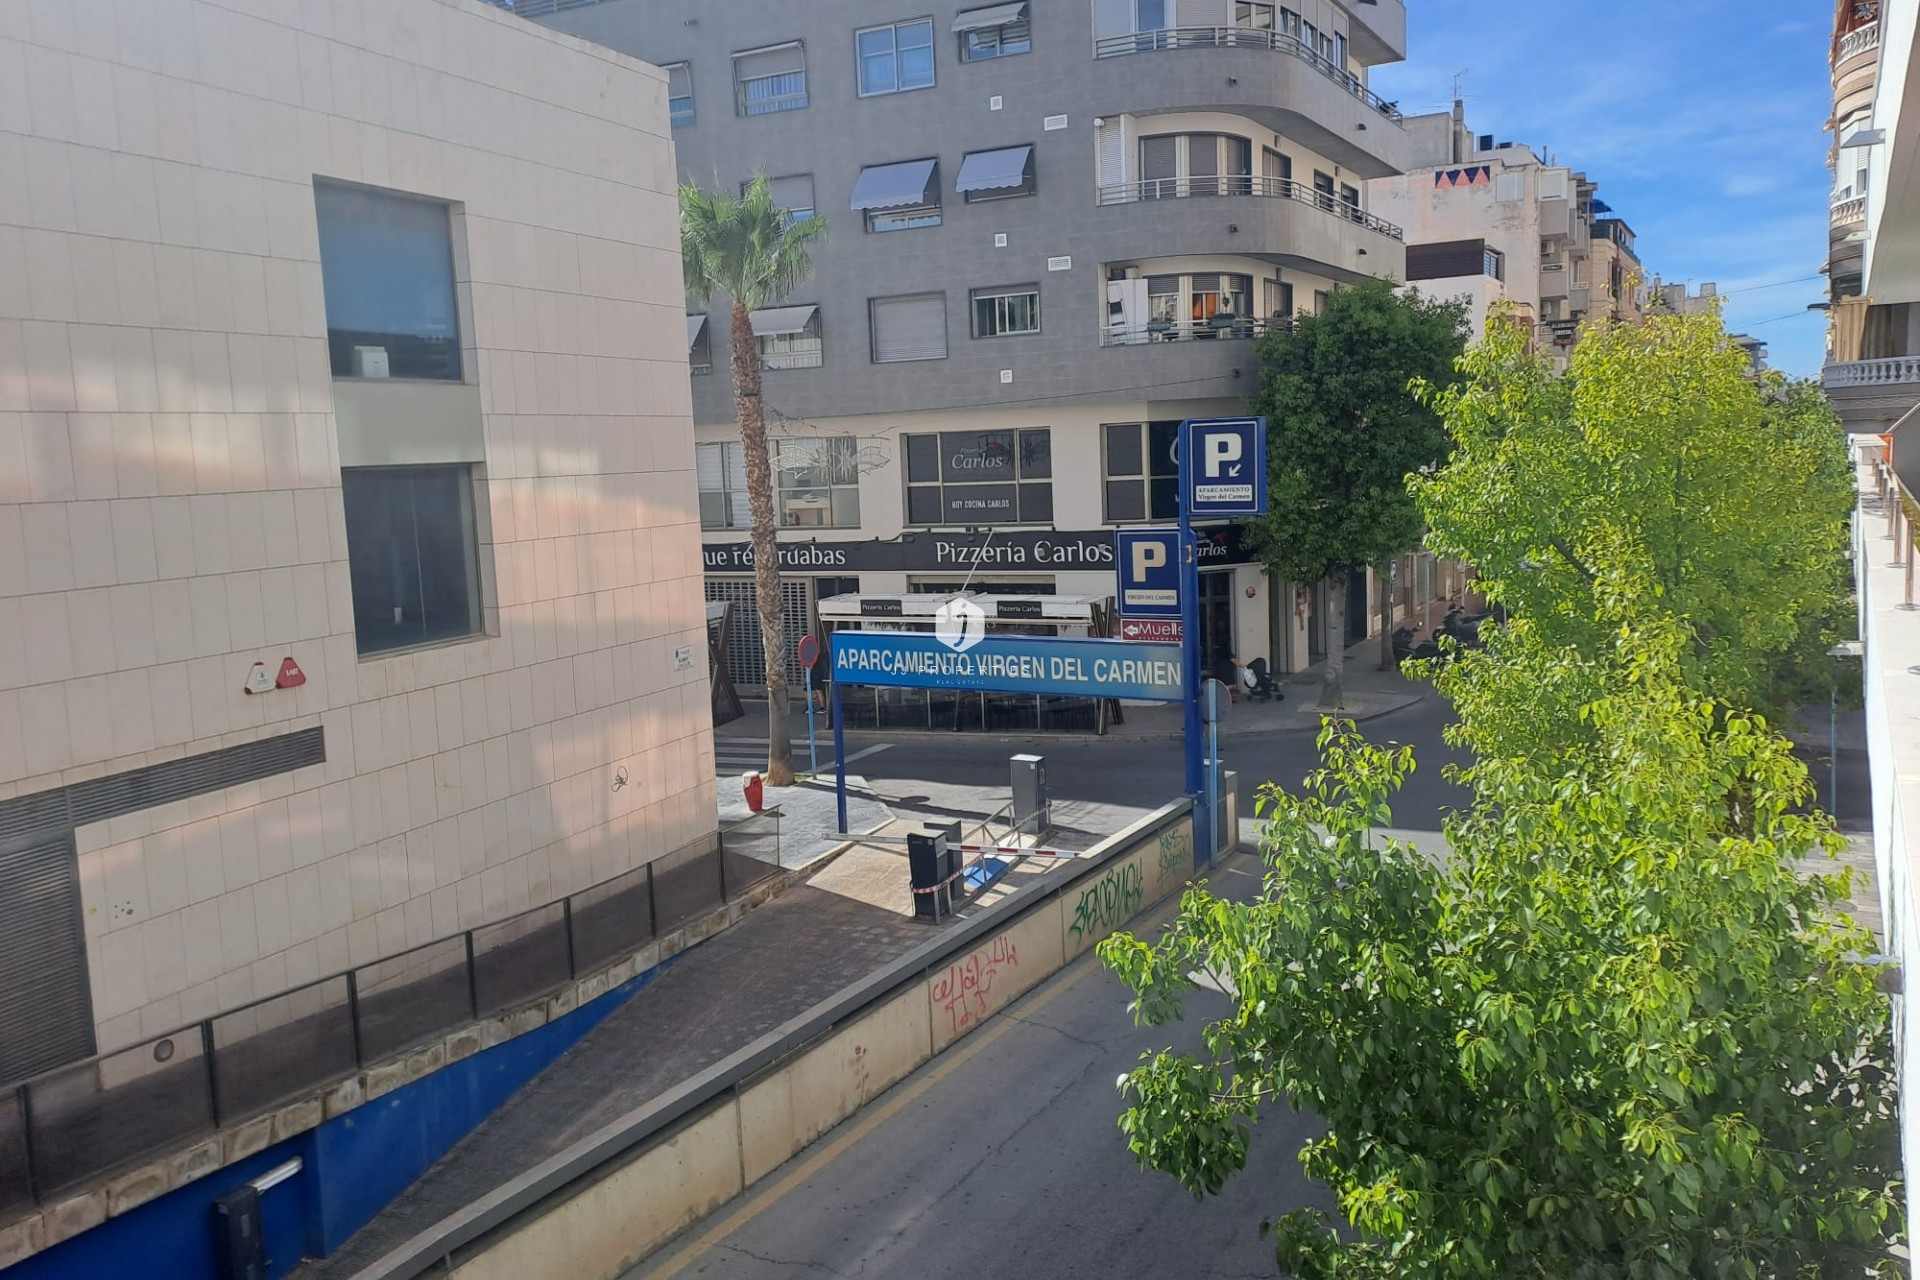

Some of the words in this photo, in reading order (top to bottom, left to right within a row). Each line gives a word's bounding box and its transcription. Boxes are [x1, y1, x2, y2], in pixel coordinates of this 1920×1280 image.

[951, 452, 1003, 469] Carlos
[1205, 433, 1242, 478] P
[951, 501, 963, 509] HOY
[964, 500, 987, 509] COCINA
[987, 499, 1010, 508] CARLOS
[935, 541, 1026, 563] Pizzería
[1034, 540, 1114, 563] Carlos
[1132, 541, 1167, 582] P
[883, 603, 901, 611] Carlos
[1022, 605, 1041, 613] Carlos
[837, 647, 970, 676] APARCAMIENTO
[975, 653, 1045, 680] VIRGEN
[1052, 656, 1089, 682] DEL
[1094, 658, 1181, 687] CARMEN
